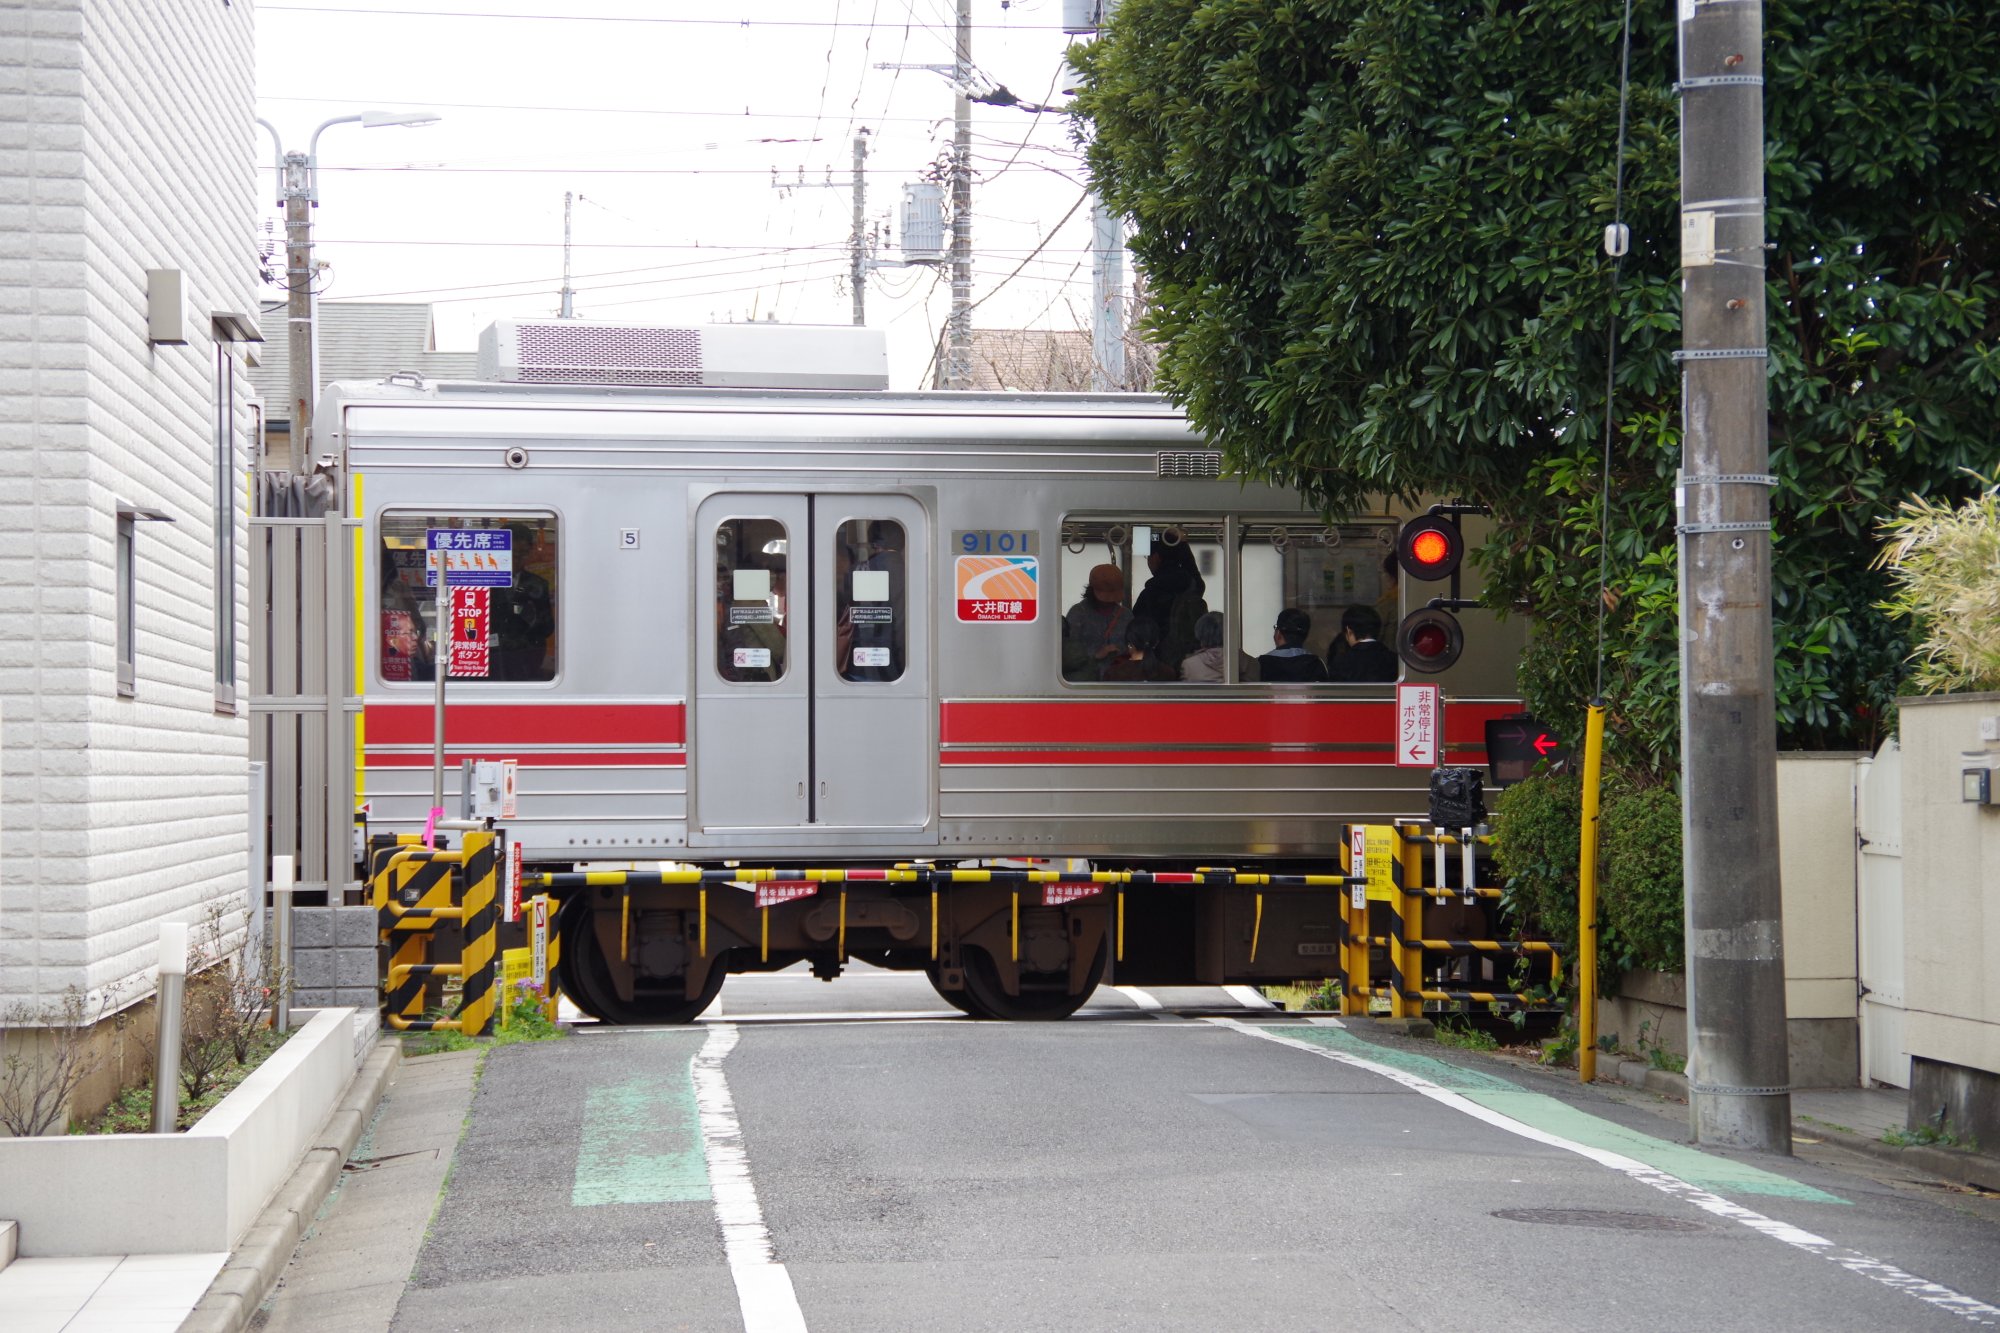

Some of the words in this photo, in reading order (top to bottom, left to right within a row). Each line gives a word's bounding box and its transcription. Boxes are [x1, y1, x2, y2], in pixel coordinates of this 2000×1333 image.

[434, 532, 492, 549] 優先席
[625, 532, 636, 545] 5
[962, 532, 1027, 553] 9101
[457, 608, 482, 618] STOP
[971, 600, 1023, 614] 大井町線
[454, 641, 485, 651] 非常停止
[457, 651, 481, 660] ボタン
[1418, 690, 1431, 742] 非常停止
[1403, 705, 1416, 742] ボタン
